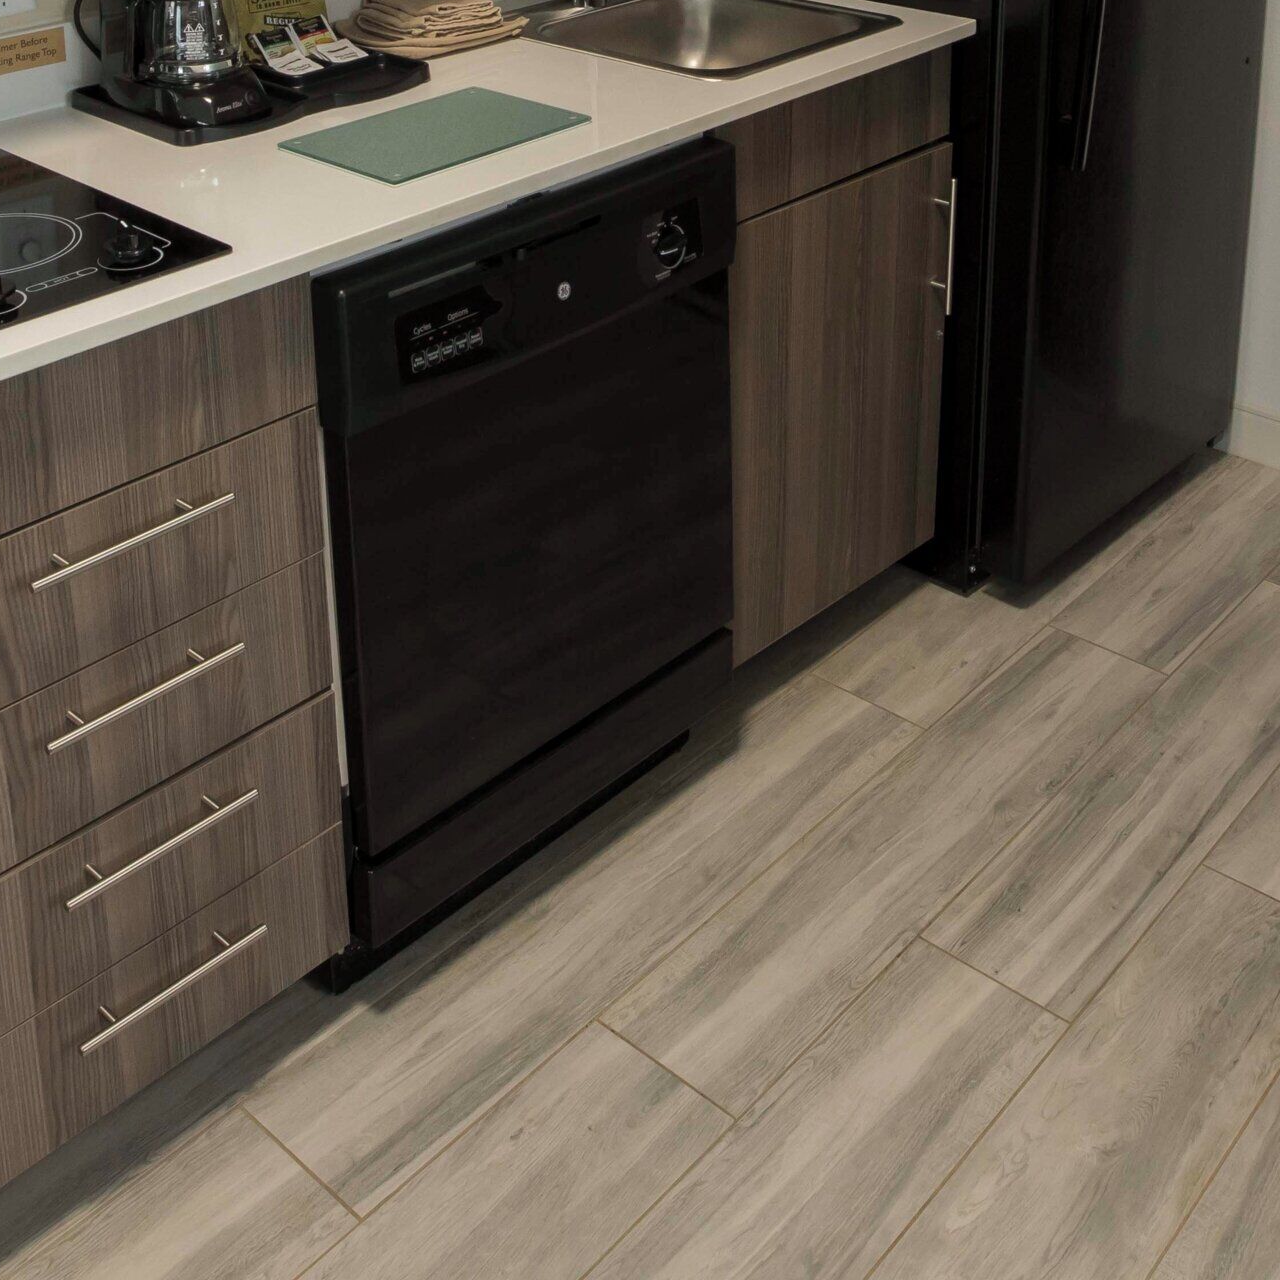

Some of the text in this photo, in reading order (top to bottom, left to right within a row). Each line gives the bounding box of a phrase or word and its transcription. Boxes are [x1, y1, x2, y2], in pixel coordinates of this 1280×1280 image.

[20, 36, 48, 48] Before
[15, 50, 40, 62] Range
[41, 47, 57, 58] Top
[447, 308, 469, 321] Options
[413, 323, 432, 335] Cycles
